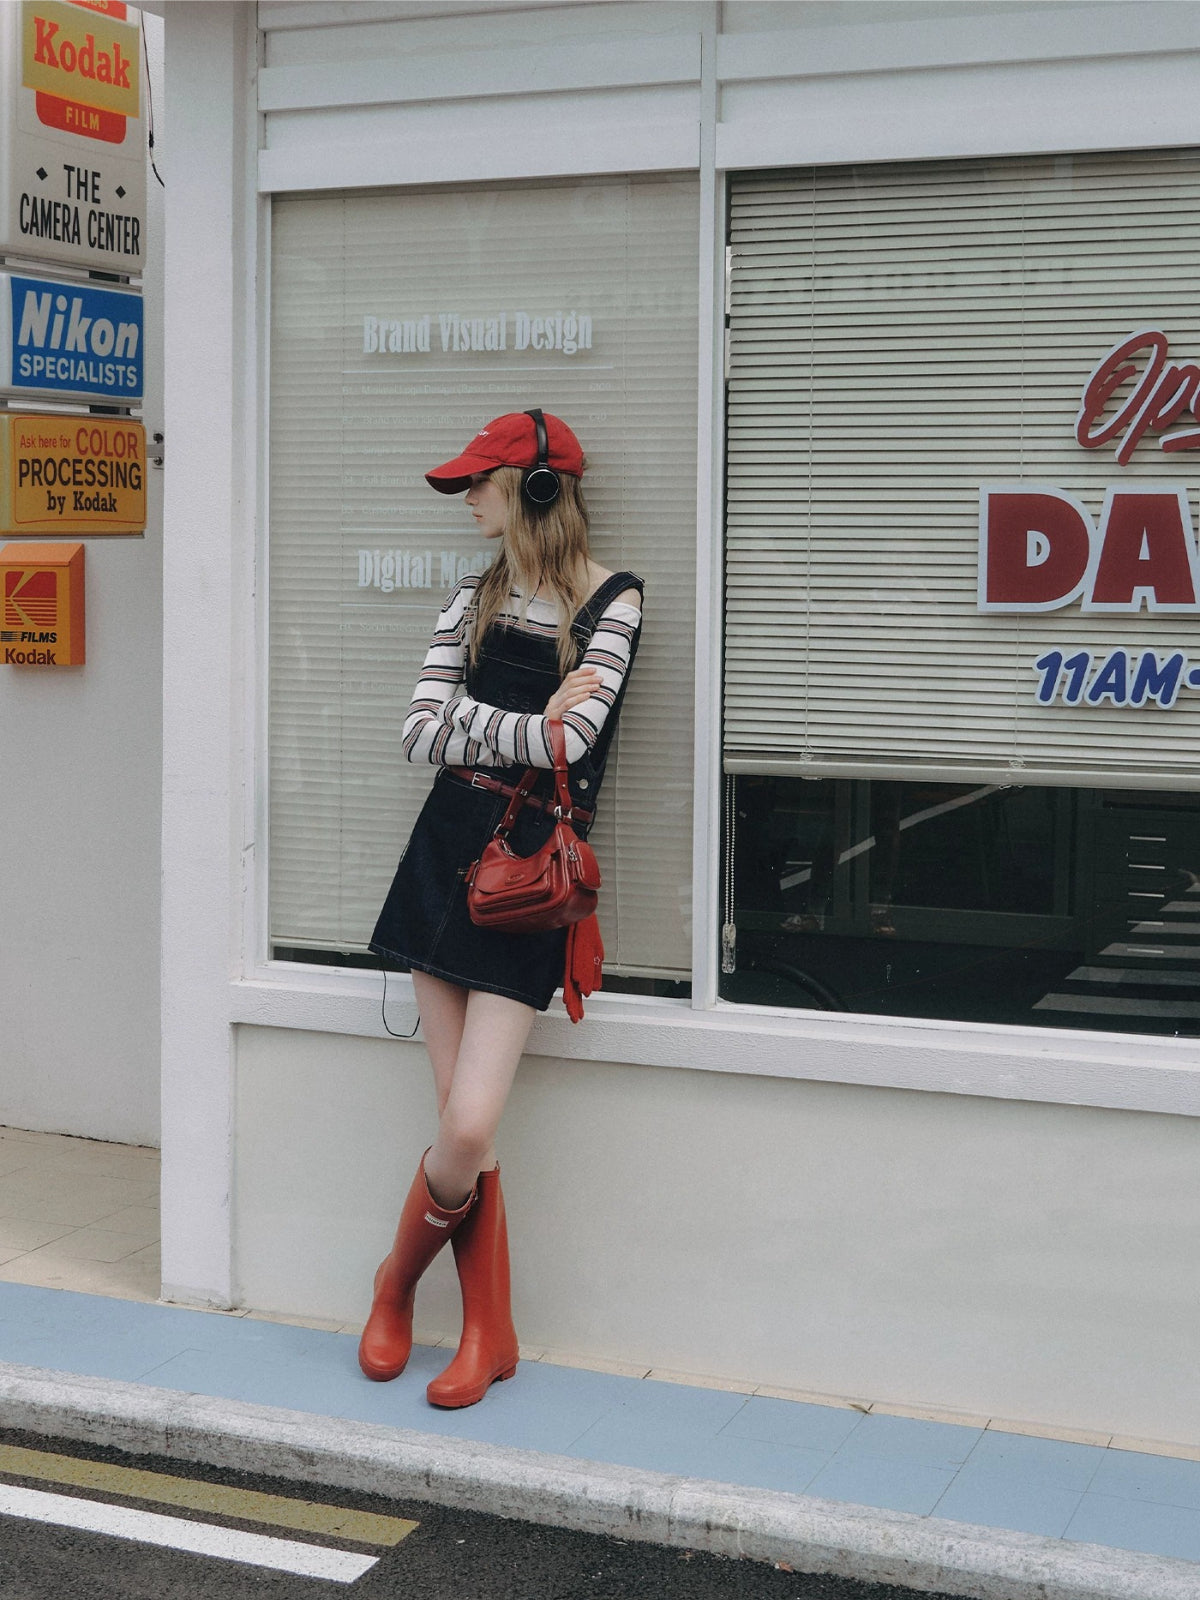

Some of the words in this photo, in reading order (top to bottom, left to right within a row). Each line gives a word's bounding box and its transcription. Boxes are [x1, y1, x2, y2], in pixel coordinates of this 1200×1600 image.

[34, 16, 131, 89] Kodak
[66, 106, 100, 132] FILM
[63, 164, 102, 204] THE
[20, 193, 81, 245] CAMERA
[88, 210, 140, 256] CENTER
[18, 290, 139, 359] Nikon
[363, 315, 431, 354] Brand
[438, 313, 506, 352] Visual
[515, 310, 593, 355] Design
[19, 353, 138, 388] SPECIALISTS
[1075, 329, 1200, 467] Op
[20, 435, 36, 449] Ask
[39, 435, 57, 449] here
[59, 435, 71, 449] for
[76, 427, 139, 460] COLOR
[18, 458, 142, 491] PROCESSING
[47, 491, 66, 515] by
[73, 491, 118, 513] Kodak
[979, 487, 1200, 610] DA
[358, 549, 432, 593] Digital
[440, 551, 492, 588] Medi
[5, 647, 56, 665] Kodak
[20, 631, 58, 643] FILMS
